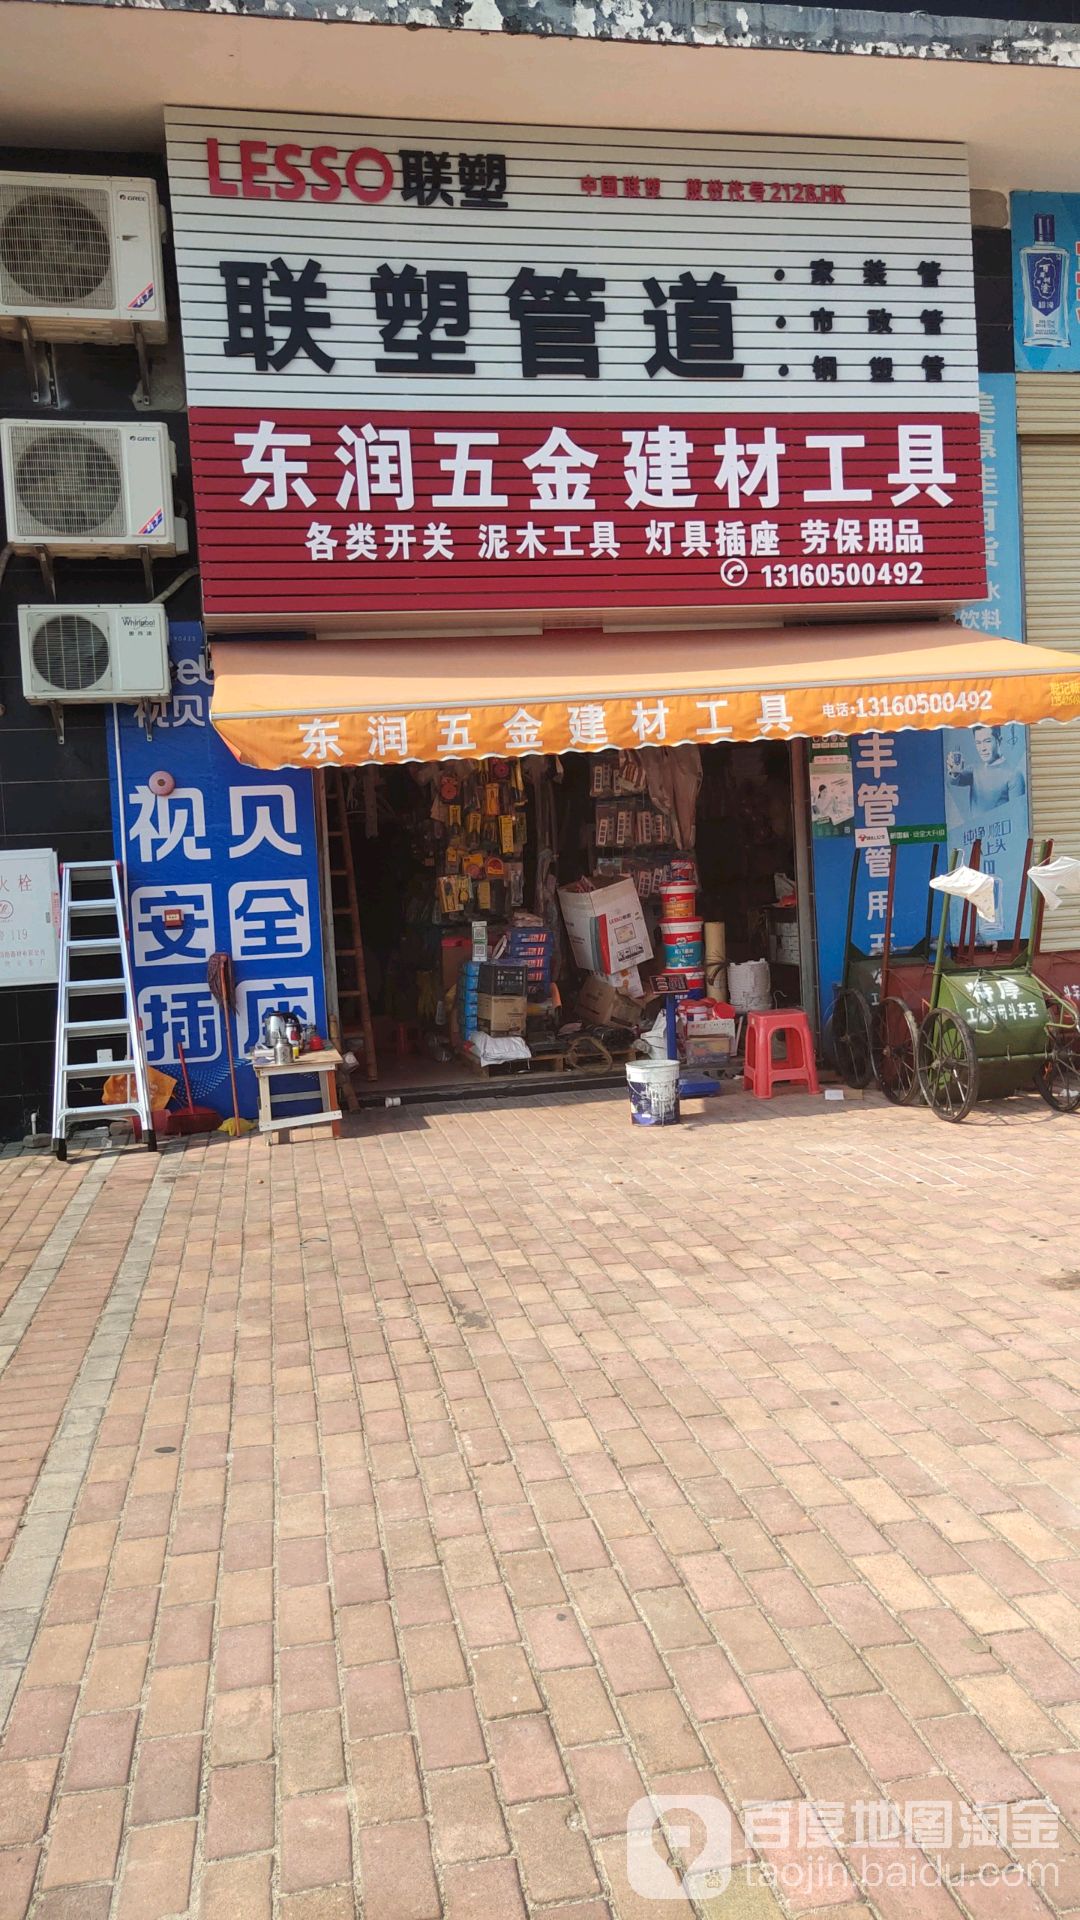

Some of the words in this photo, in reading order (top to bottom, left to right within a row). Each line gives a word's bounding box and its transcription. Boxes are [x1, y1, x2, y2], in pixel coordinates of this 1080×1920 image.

[219, 256, 744, 378] 联塑管道
[233, 420, 957, 512] 东润五金建材工具
[304, 522, 455, 561] 各类开关
[478, 521, 622, 559] 泥木工具
[645, 520, 781, 558] 灯具插座
[799, 518, 925, 554] 劳保用品
[760, 562, 924, 588] 13160500492
[298, 694, 793, 760] 东润五金建材工具
[129, 784, 302, 862] 视贝
[138, 888, 304, 962] 安全
